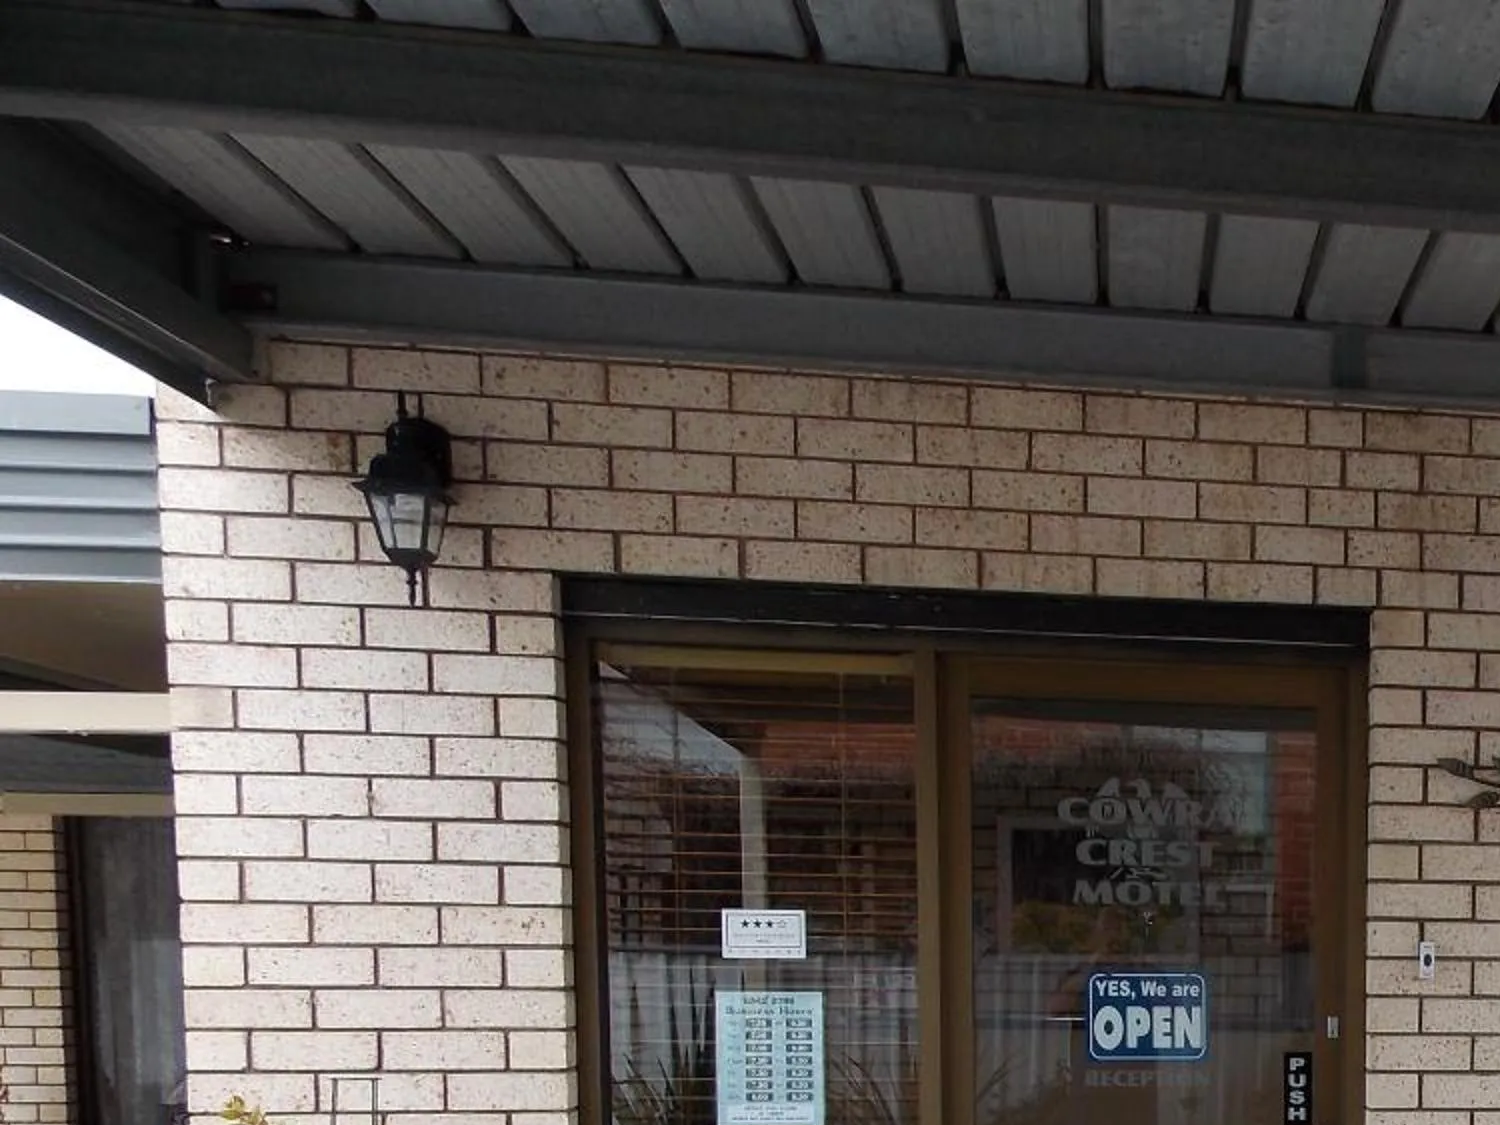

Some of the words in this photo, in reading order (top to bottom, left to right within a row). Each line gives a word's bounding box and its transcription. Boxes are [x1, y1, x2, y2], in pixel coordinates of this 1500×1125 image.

[1057, 796, 1237, 827] COWRA
[1075, 838, 1221, 868] CREST
[1072, 879, 1227, 911] MOTEL
[1094, 979, 1136, 1000] YES,
[1139, 979, 1167, 998] We
[1171, 983, 1201, 998] are
[1093, 1004, 1202, 1051] OPEN
[1287, 1057, 1307, 1121] PUSH
